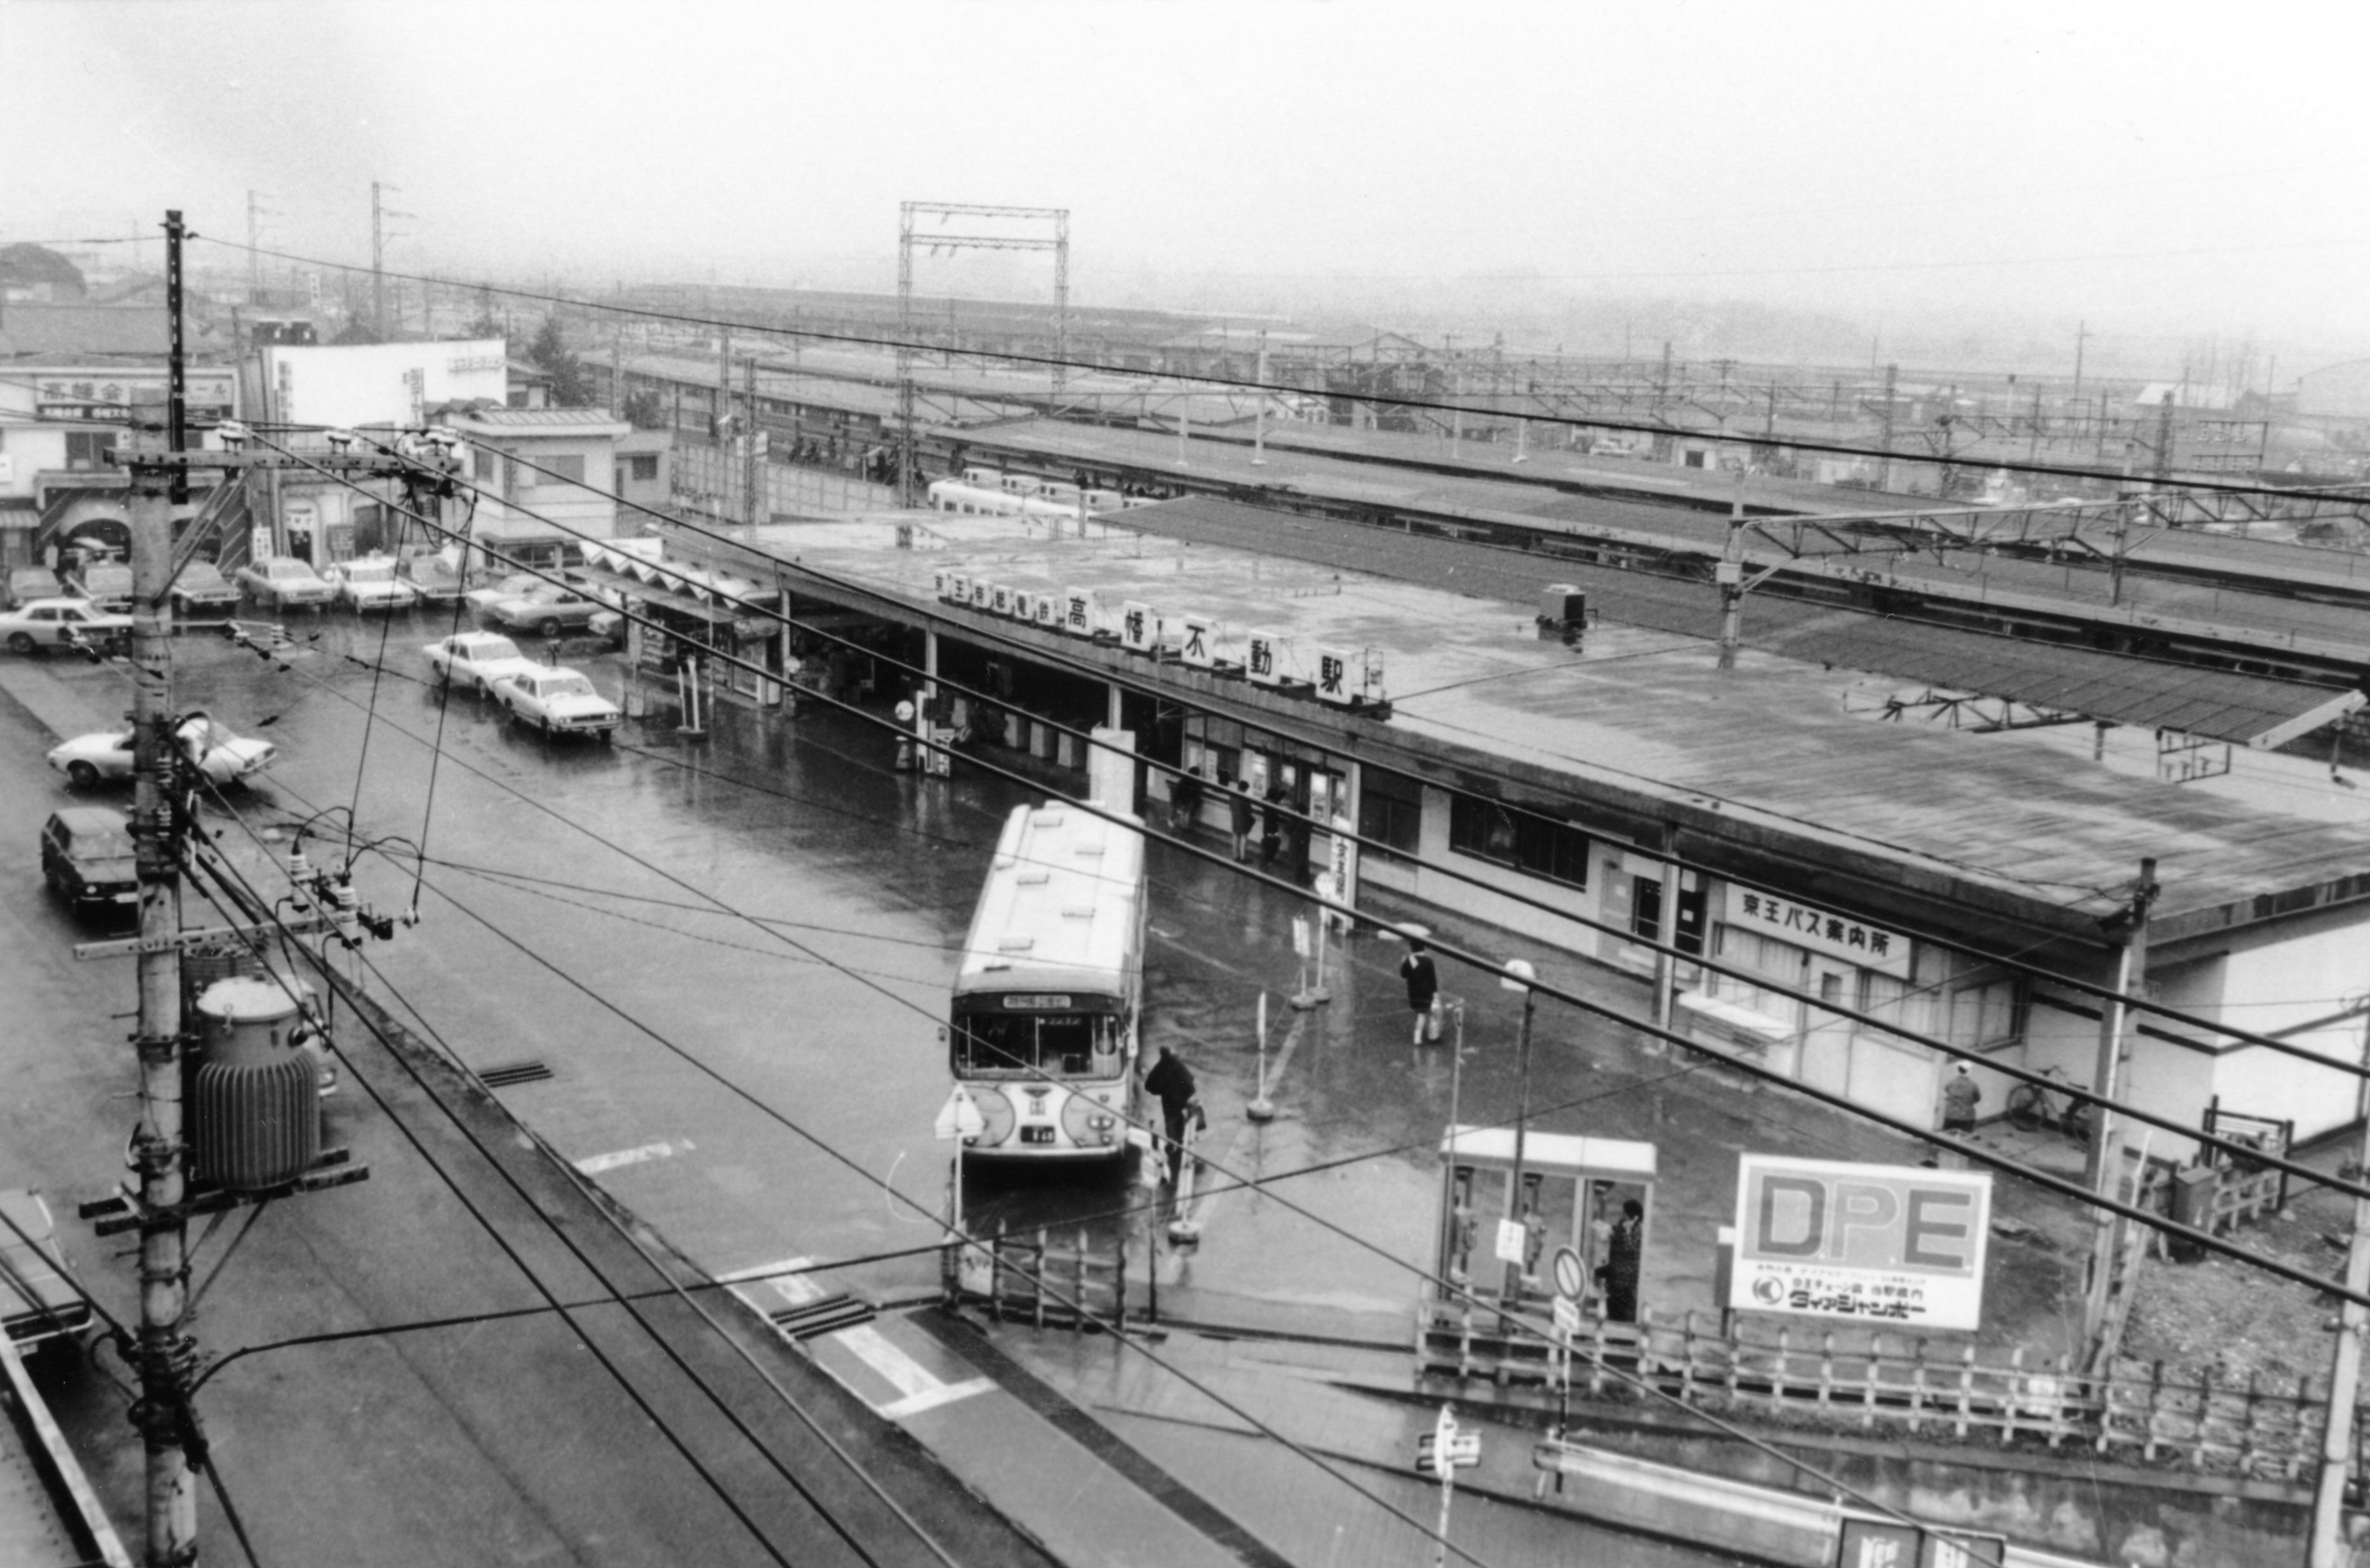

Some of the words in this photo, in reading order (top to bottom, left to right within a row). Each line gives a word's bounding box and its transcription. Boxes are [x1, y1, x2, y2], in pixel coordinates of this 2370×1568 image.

[1068, 597, 1343, 696] 高幡不動駅
[1744, 894, 1889, 957] 京王バス案内所
[1757, 1175, 1972, 1269] DPE
